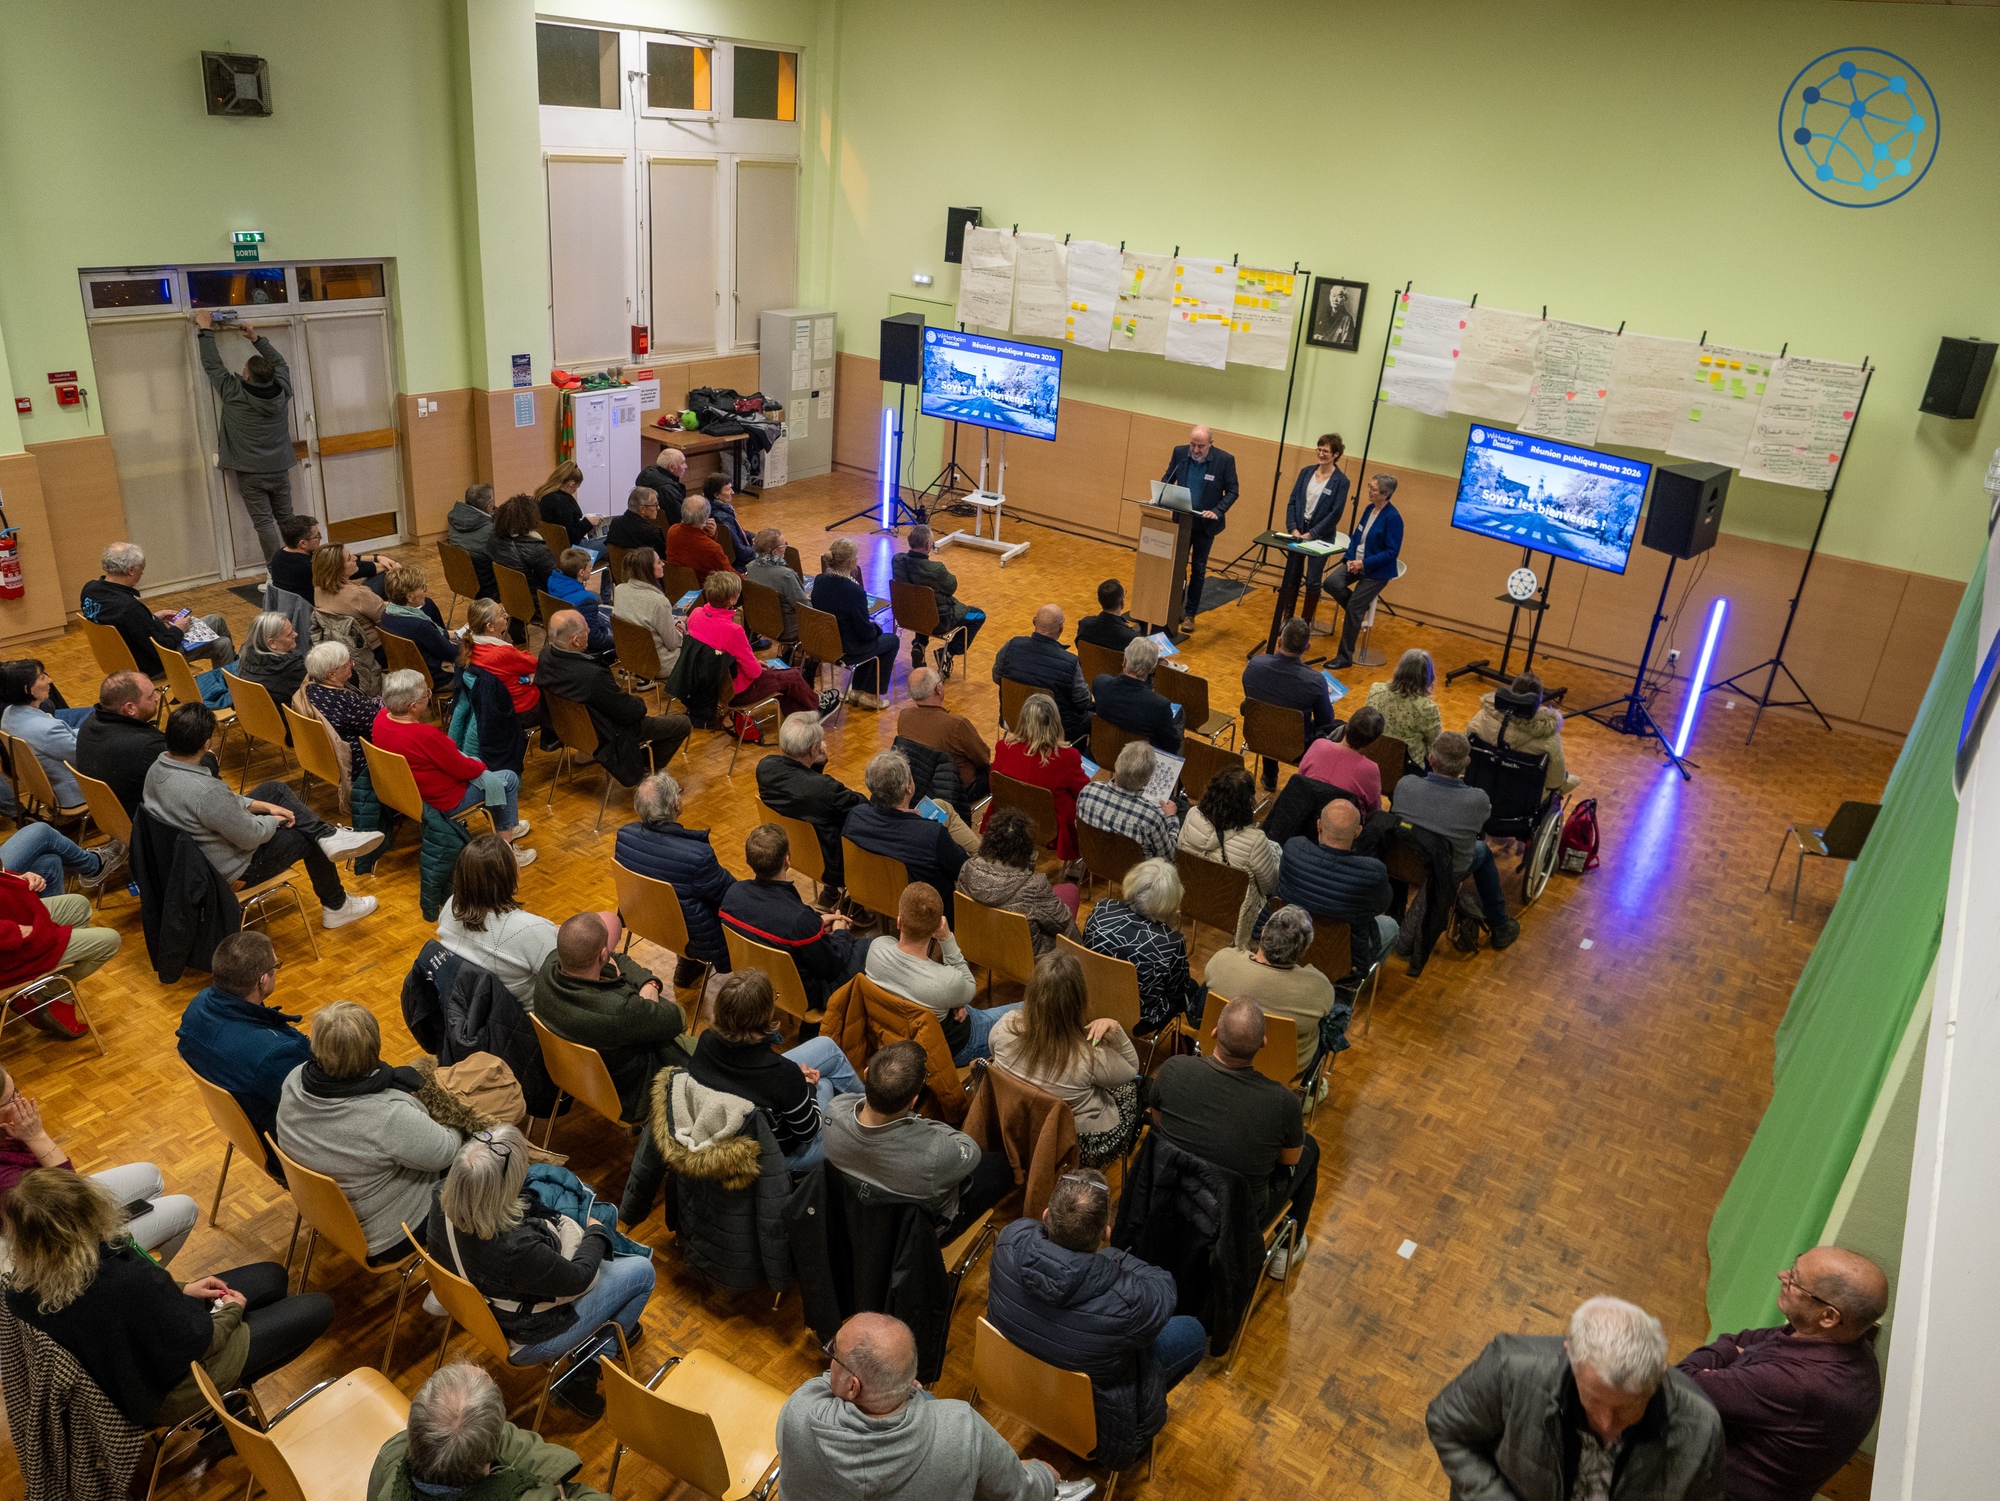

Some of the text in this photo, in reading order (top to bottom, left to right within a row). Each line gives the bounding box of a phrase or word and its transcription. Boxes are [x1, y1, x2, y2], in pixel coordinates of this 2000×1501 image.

[972, 341, 1056, 362] Réunion publique mars 2026
[941, 380, 968, 396] Soyez
[969, 387, 983, 396] les
[984, 388, 1031, 406] bienvenus
[1492, 439, 1514, 451] Demain
[1530, 445, 1642, 478] Réunion publique mars 2026
[1482, 489, 1607, 531] Soyez les bienvenus !
